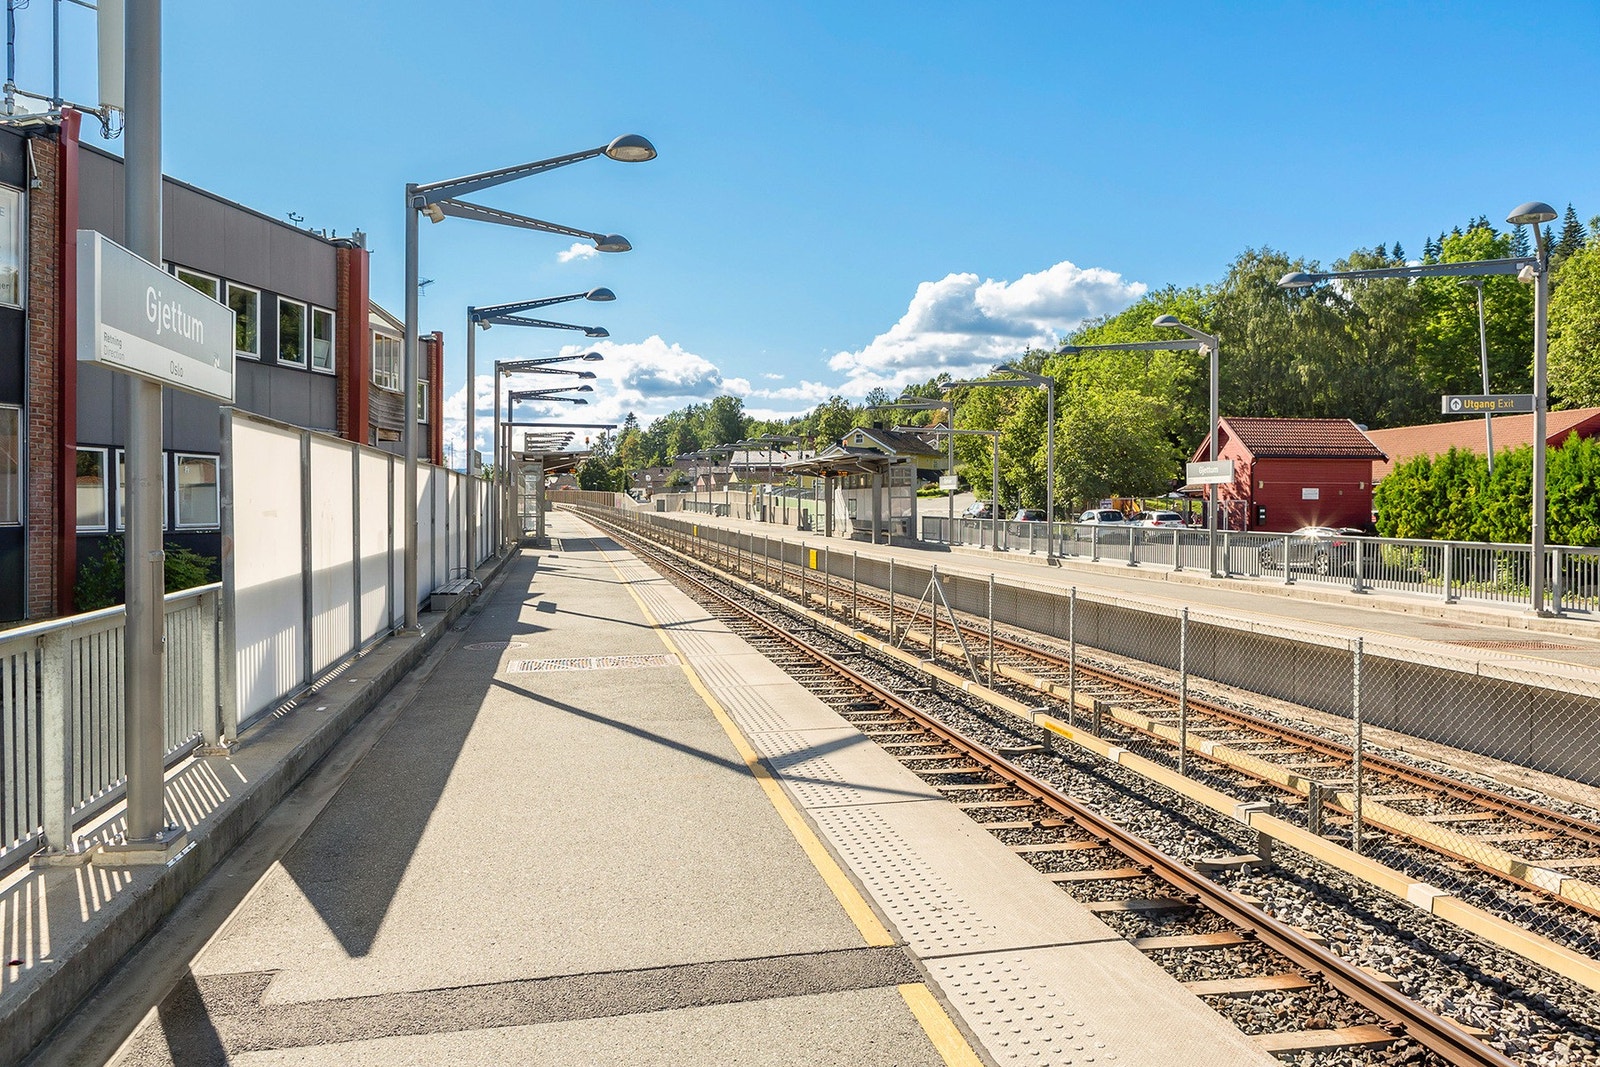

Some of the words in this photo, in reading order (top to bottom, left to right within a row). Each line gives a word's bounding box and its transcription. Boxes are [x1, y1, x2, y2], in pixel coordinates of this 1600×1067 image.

[146, 286, 204, 344] Gjettum
[103, 345, 125, 361] Direction
[170, 360, 183, 377] Oslo
[1463, 399, 1495, 410] Utgang
[1497, 399, 1514, 408] Exit
